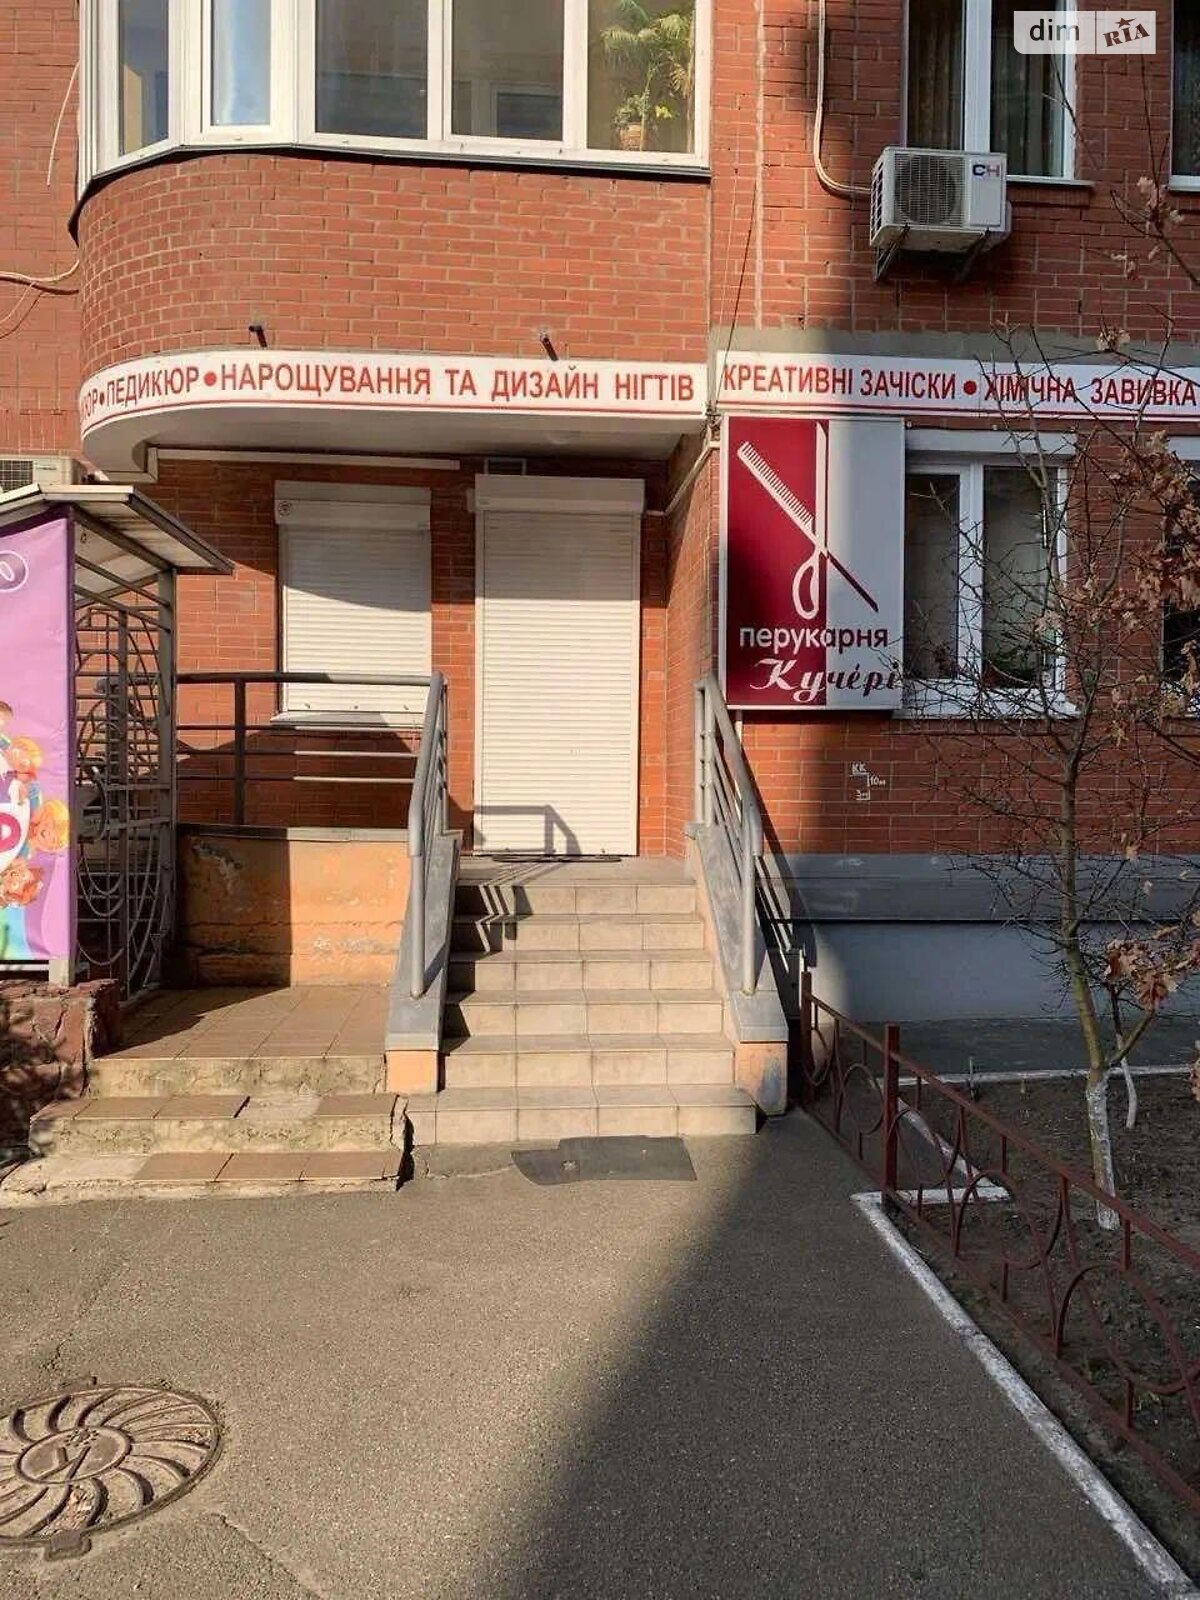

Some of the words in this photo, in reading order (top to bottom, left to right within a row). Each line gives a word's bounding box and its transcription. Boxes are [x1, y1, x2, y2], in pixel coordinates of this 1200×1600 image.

[107, 367, 200, 407] ПЕДИКЮР
[221, 363, 431, 397] НАРОЩУВАННЯ
[444, 369, 477, 396] ТА
[491, 367, 599, 402] ДИЗАЙН
[614, 373, 695, 401] НІГТІВ
[723, 364, 853, 395] КРЕАТИВНІ
[860, 369, 956, 399] ЗАЧІСКИ
[1090, 378, 1197, 405] ЗАВИВКА
[739, 627, 889, 655] перукарня
